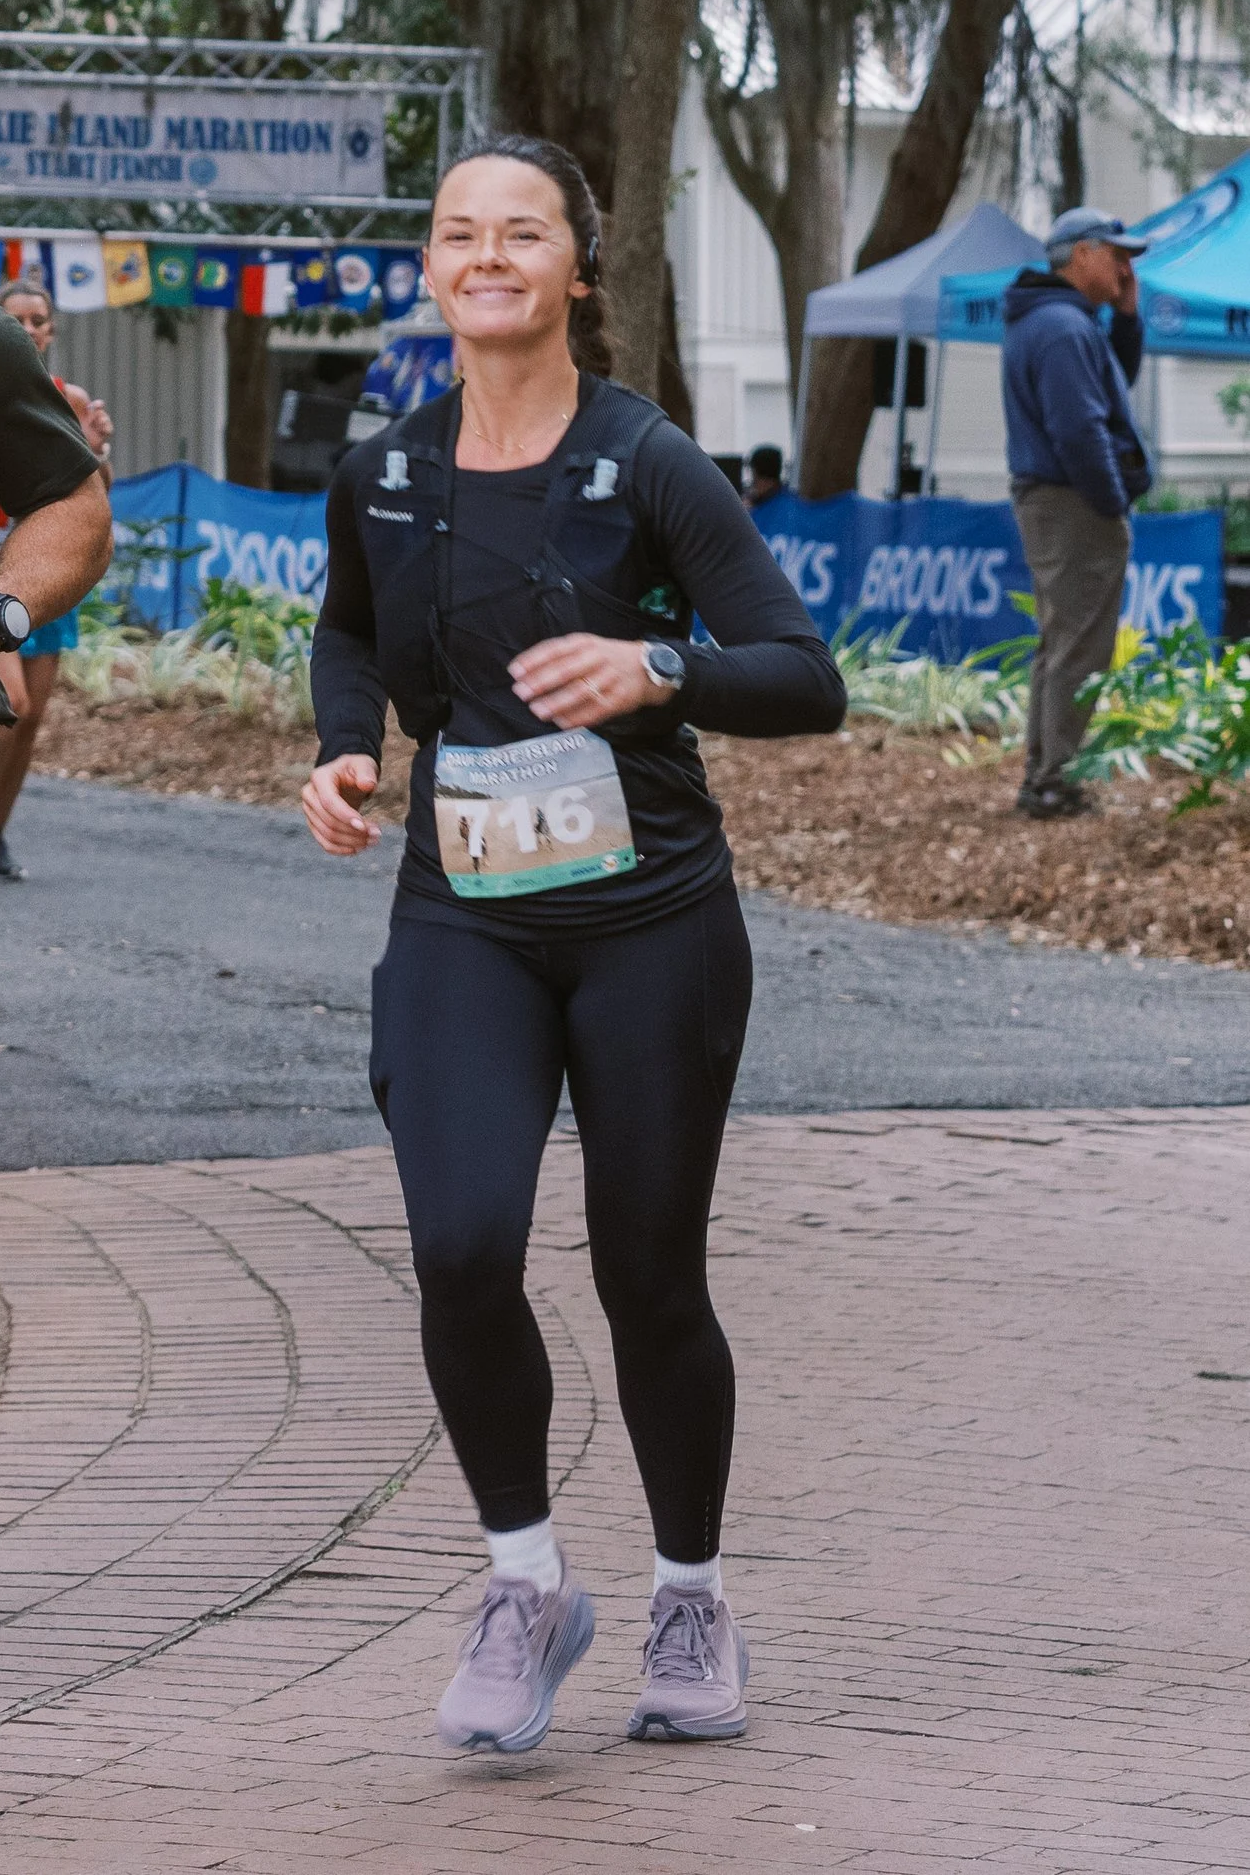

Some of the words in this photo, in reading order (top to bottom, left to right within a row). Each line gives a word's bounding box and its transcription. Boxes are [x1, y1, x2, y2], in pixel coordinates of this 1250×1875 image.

[47, 112, 151, 148] ILAND
[163, 115, 332, 155] MARATHON
[860, 545, 1008, 618] BROOKS
[525, 733, 587, 761] ISLAND
[456, 785, 595, 854] 716
